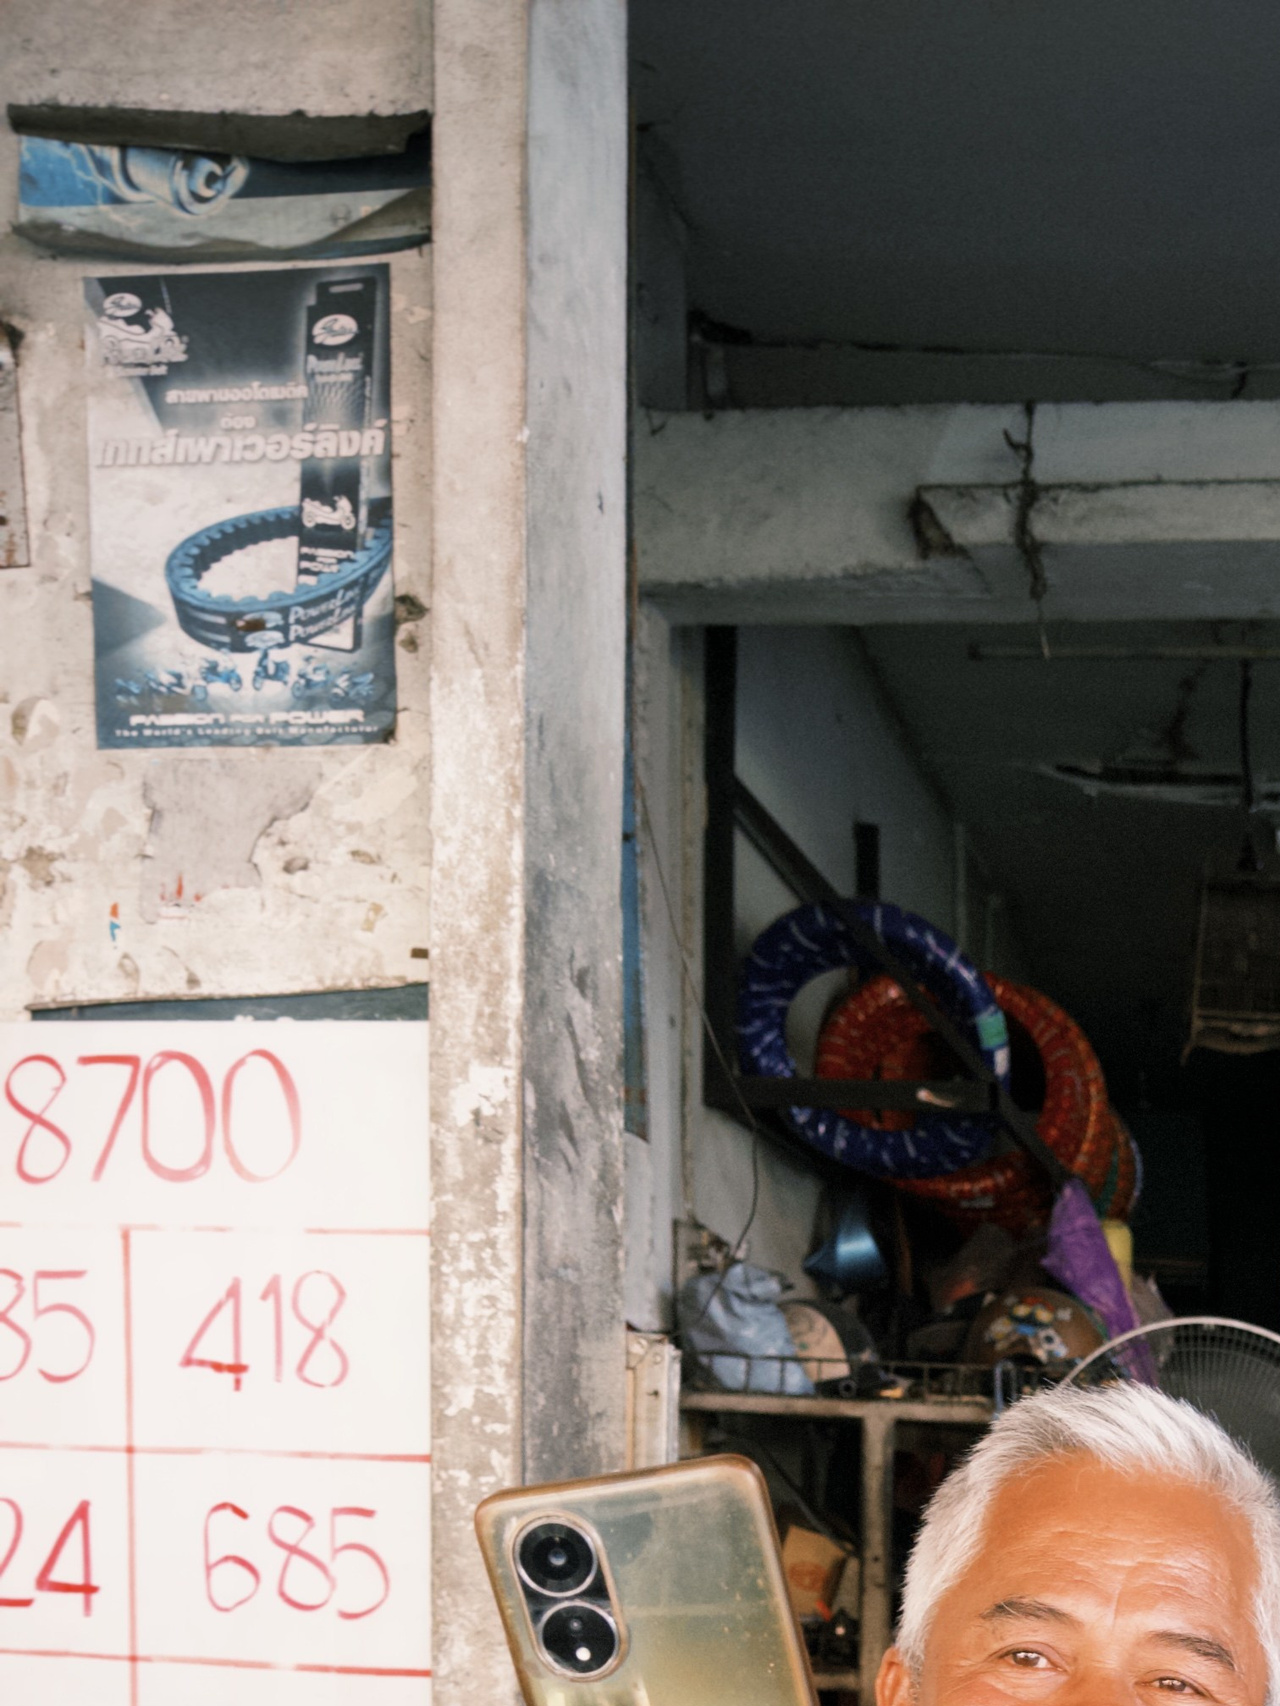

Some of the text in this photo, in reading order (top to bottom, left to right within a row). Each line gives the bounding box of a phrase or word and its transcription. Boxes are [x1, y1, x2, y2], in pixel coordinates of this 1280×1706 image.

[129, 712, 225, 727] PASSION
[269, 709, 365, 725] POWER
[178, 1269, 350, 1393] 418
[203, 1500, 391, 1621] 685
